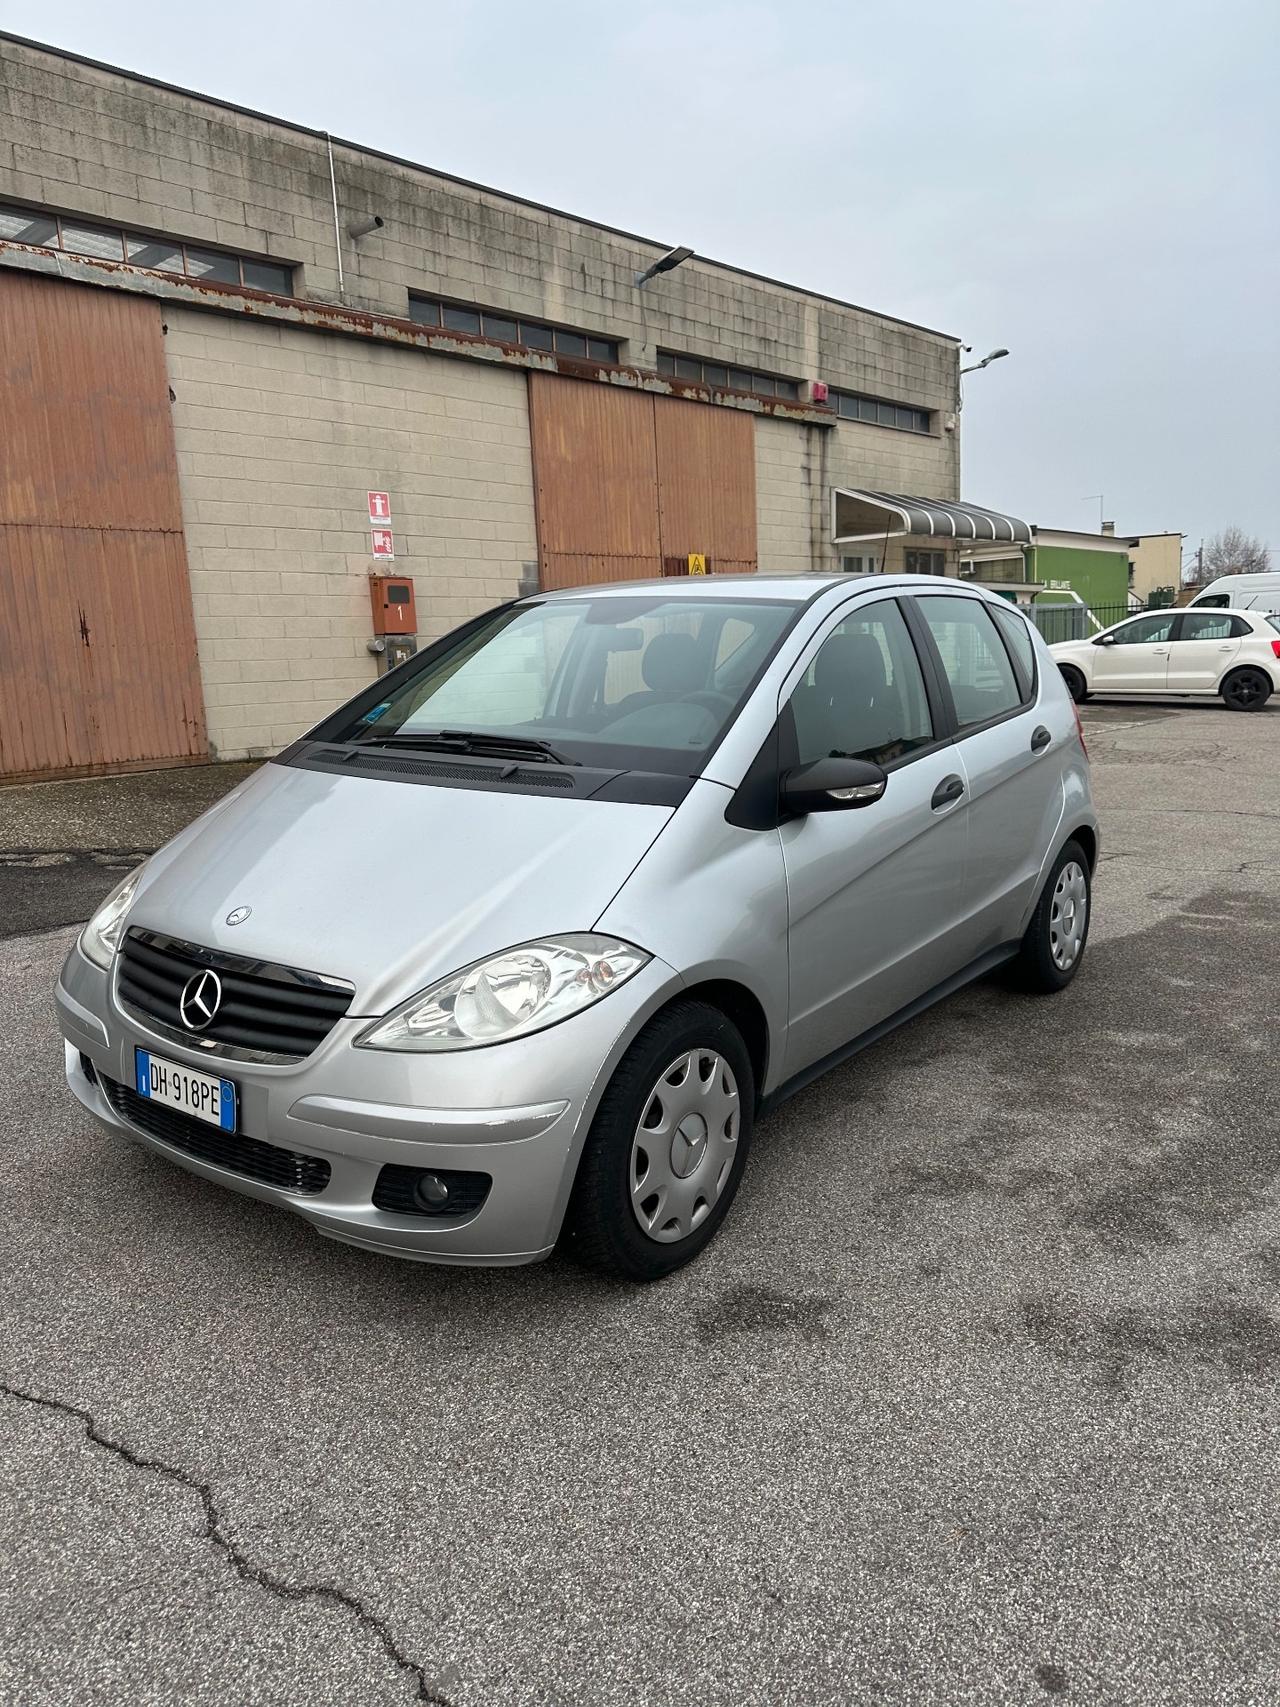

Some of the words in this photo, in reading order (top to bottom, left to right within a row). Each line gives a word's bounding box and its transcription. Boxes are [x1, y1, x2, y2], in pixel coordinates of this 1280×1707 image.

[397, 605, 403, 621] 1
[150, 1062, 168, 1096] DH
[172, 1072, 220, 1116] 918PE
